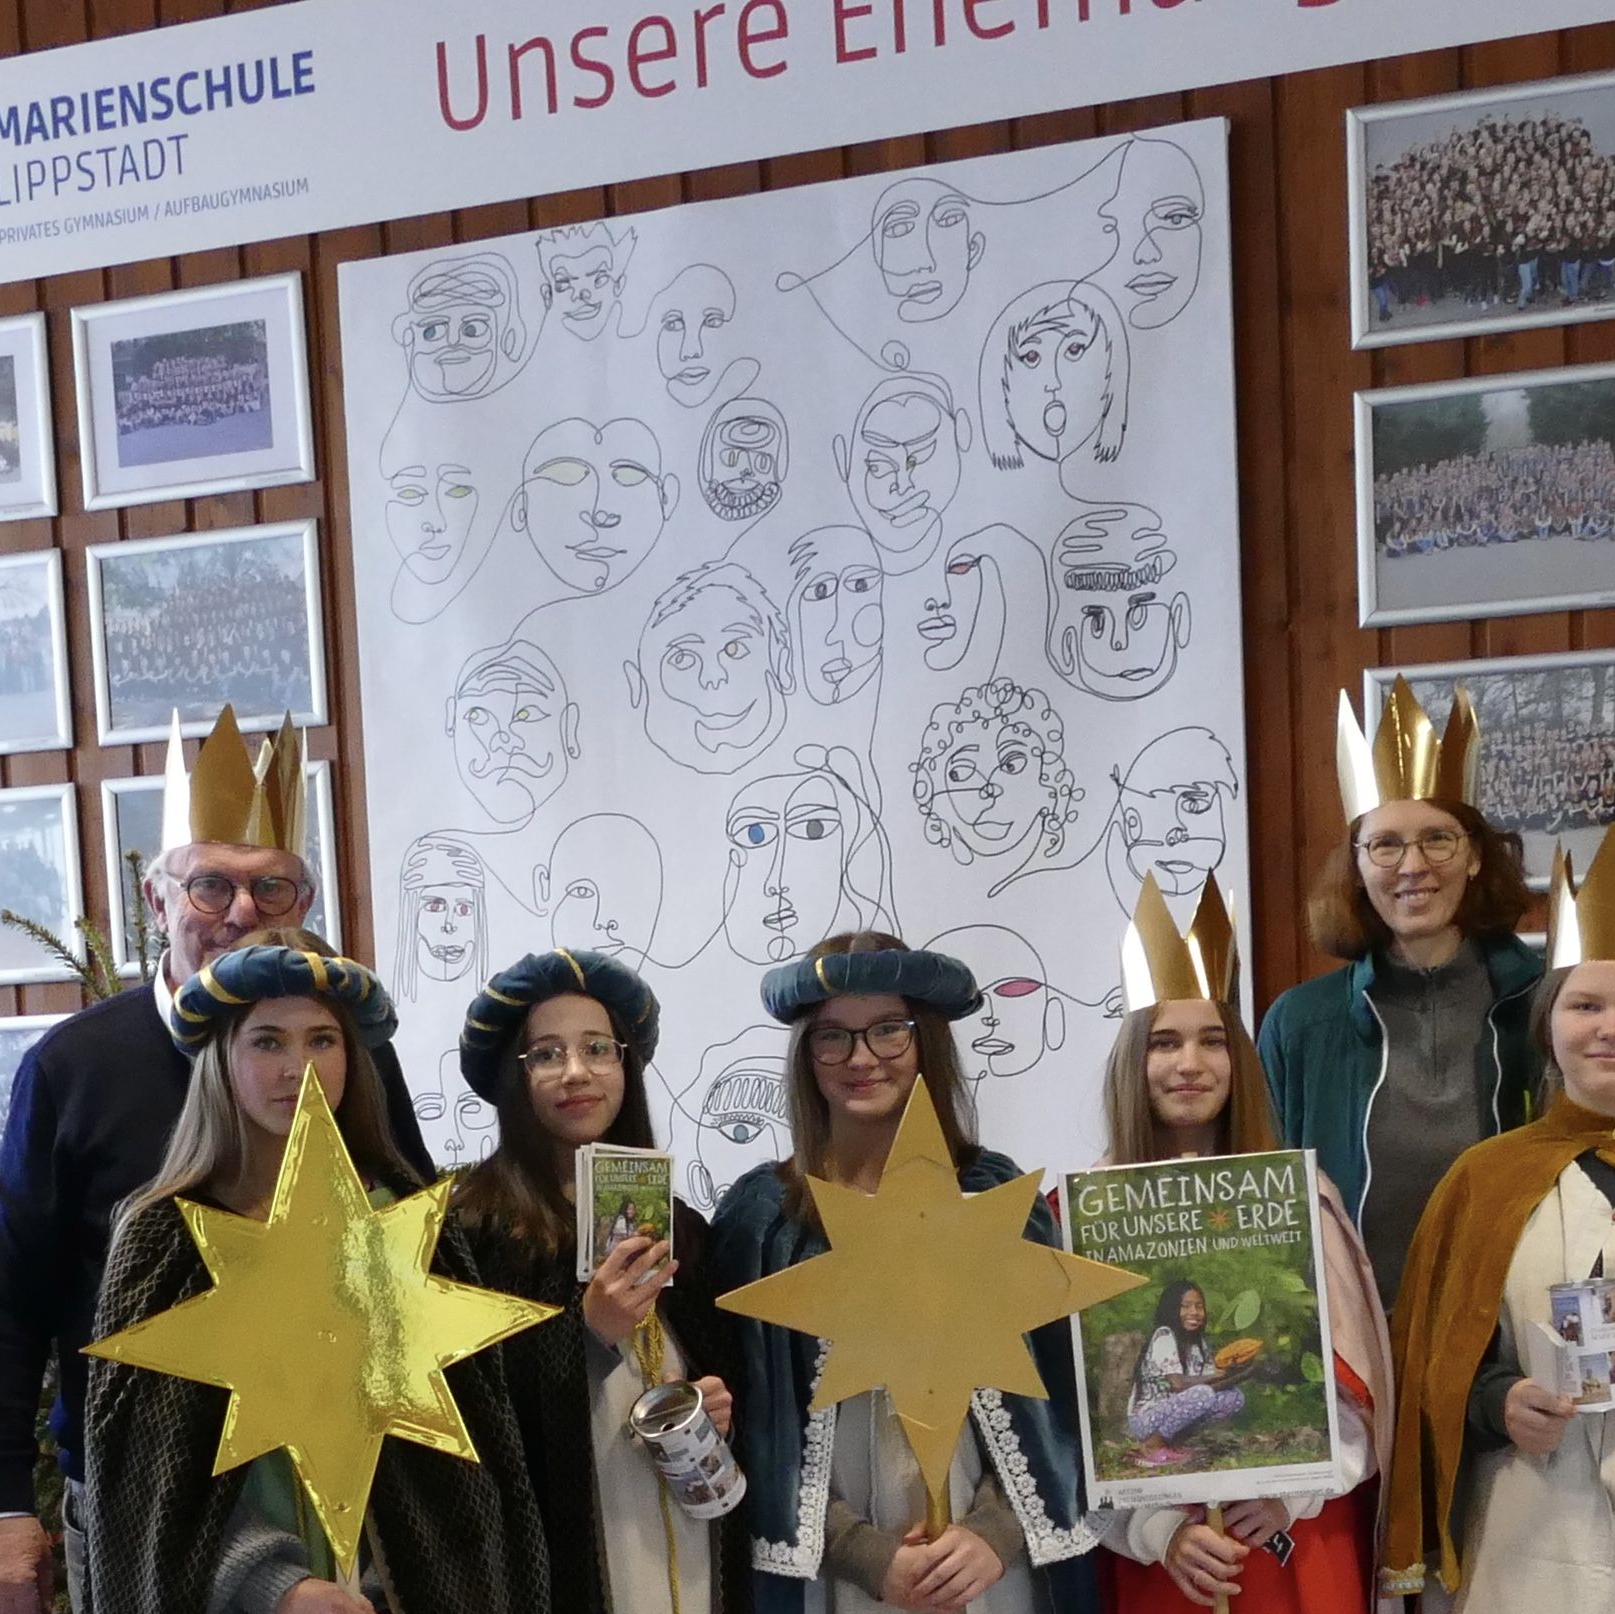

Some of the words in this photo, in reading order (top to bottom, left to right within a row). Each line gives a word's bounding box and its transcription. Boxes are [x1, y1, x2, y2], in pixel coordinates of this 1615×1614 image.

[436, 0, 789, 131] Unsere
[63, 204, 149, 235] GYMNASIUM
[153, 203, 161, 222] /
[164, 177, 310, 218] AUFBAUGYMNASIUM
[594, 1160, 668, 1174] GEMEINSAM
[1078, 1164, 1296, 1217] GEMEINSAM
[1081, 1218, 1121, 1244] FÜR
[1123, 1209, 1203, 1237] UNSERE
[1237, 1199, 1300, 1231] ERDE
[1107, 1237, 1207, 1263] AMAZONIEN
[1212, 1236, 1239, 1250] UND
[1239, 1230, 1302, 1249] WELTWEIT
